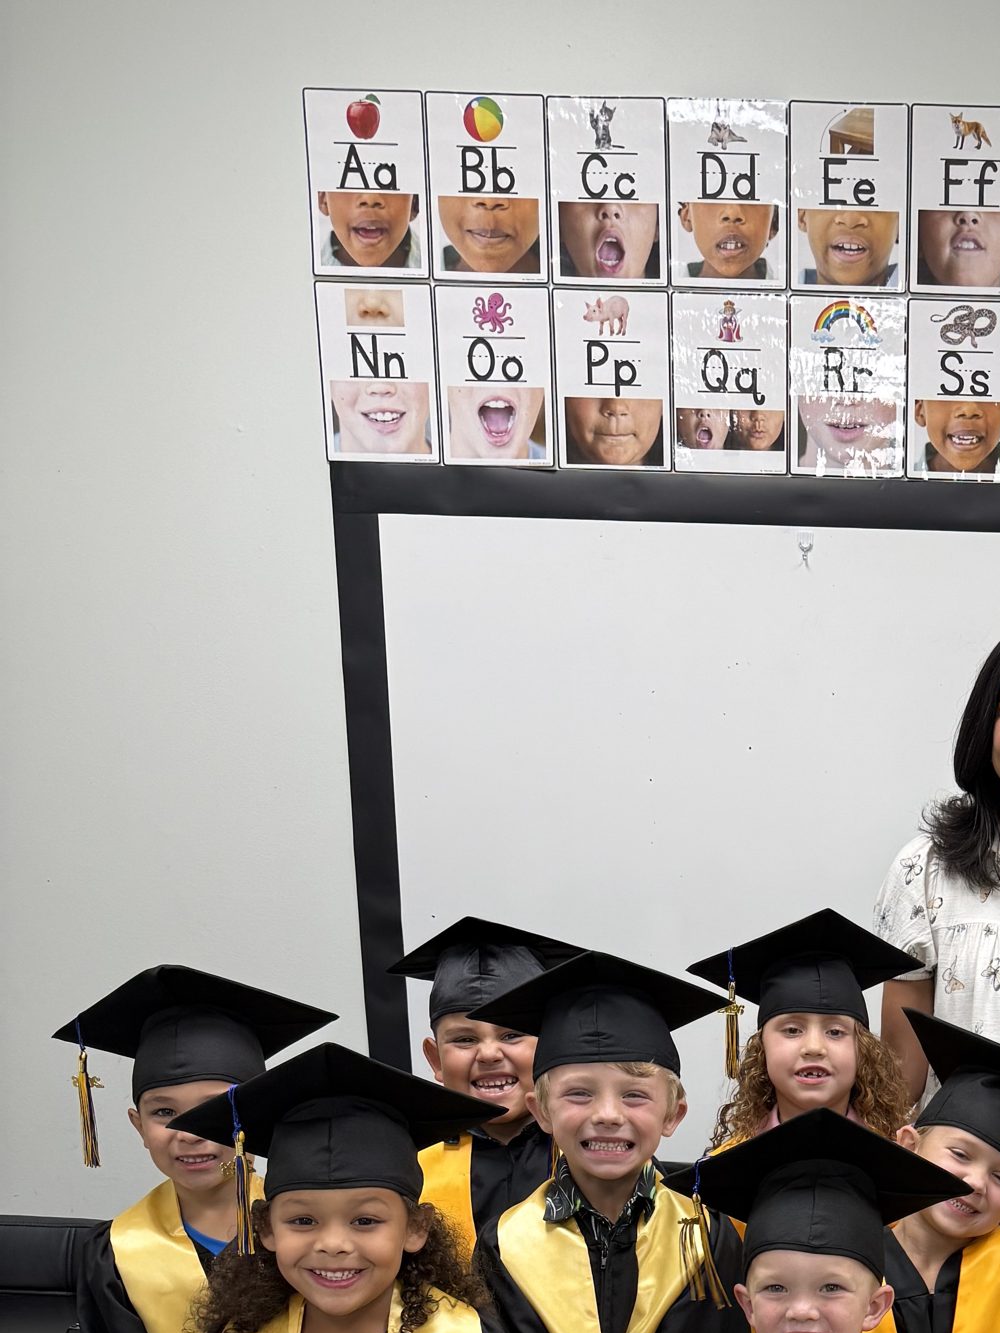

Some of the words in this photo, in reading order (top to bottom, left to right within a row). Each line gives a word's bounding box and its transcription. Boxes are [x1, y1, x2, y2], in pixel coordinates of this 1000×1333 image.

[339, 143, 398, 190] Aa
[461, 146, 516, 193] Bb
[581, 153, 636, 199] Cc
[700, 153, 757, 200] Dd
[823, 160, 876, 205] Ee
[944, 160, 996, 205] Ff
[351, 333, 406, 378] Nn
[468, 338, 523, 381] Oo
[586, 342, 637, 396] Pp
[701, 349, 764, 405] Qq
[823, 348, 873, 391] Rr
[940, 352, 990, 396] Ss
